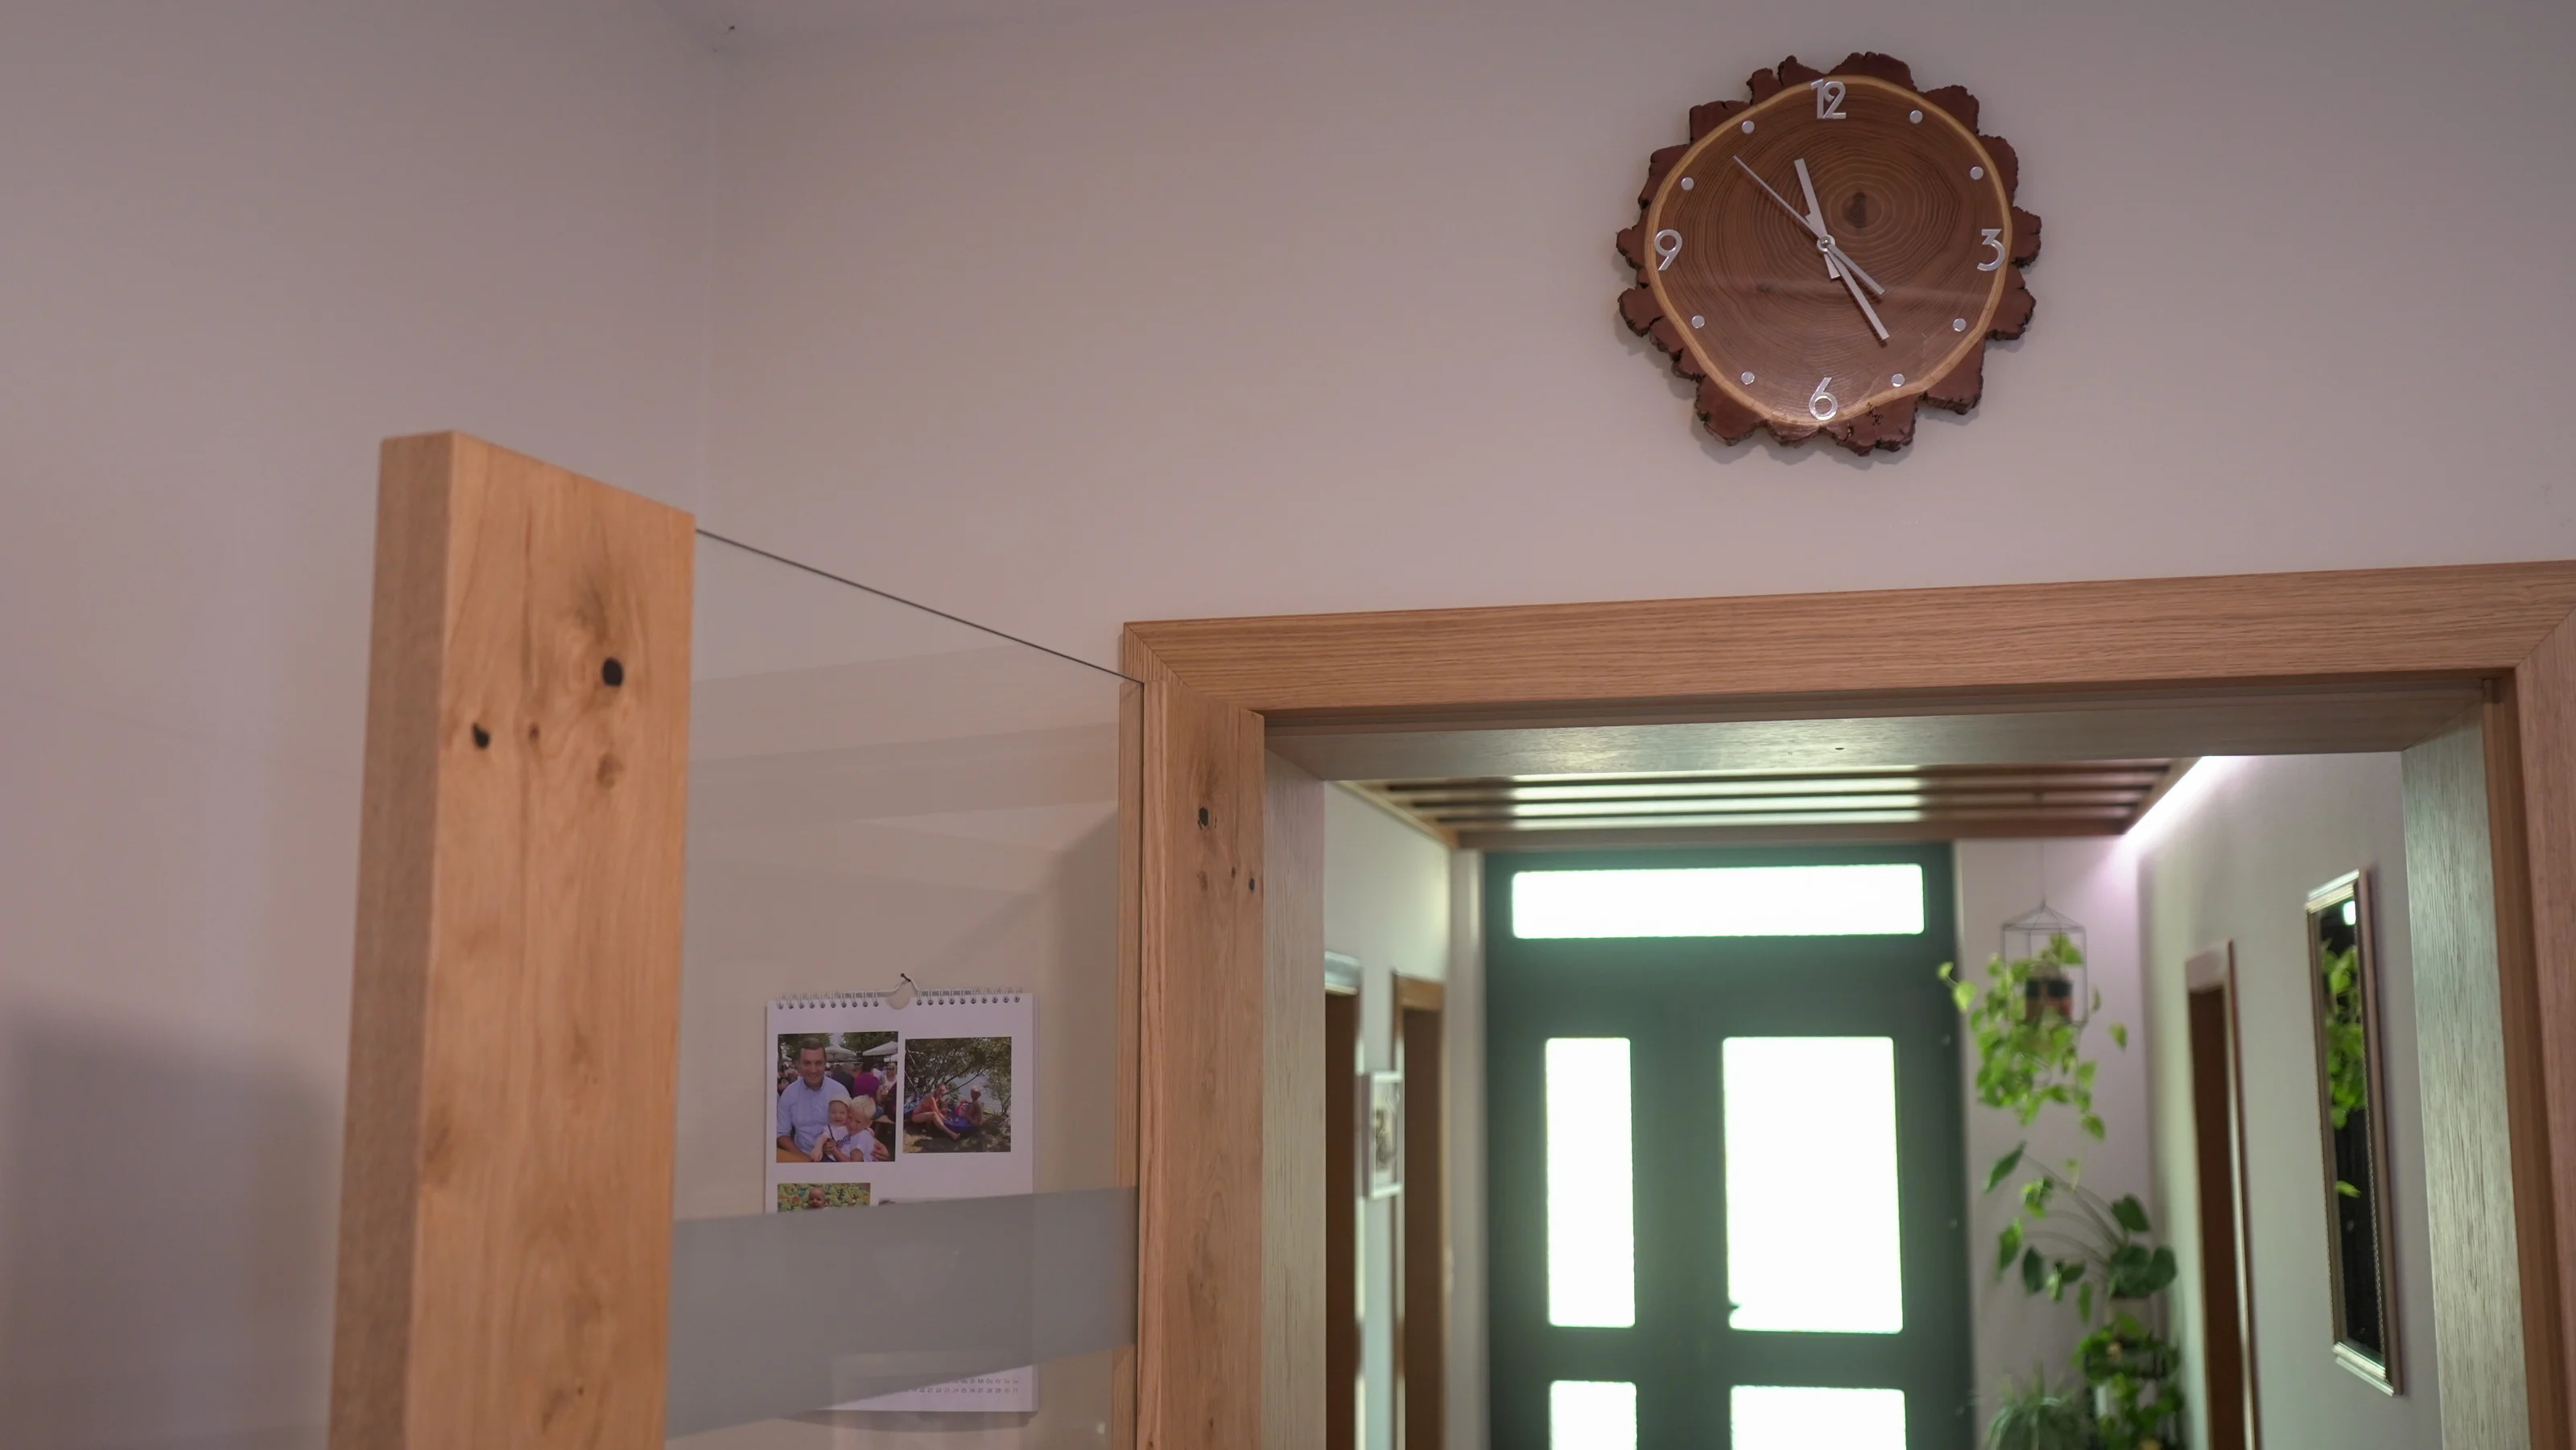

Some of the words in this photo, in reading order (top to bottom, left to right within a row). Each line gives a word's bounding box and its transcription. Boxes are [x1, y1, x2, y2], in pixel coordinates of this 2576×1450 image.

[1810, 78, 1847, 119] 12
[1653, 229, 1682, 271] 9
[1976, 229, 2005, 271] 3
[1809, 377, 1838, 420] 6
